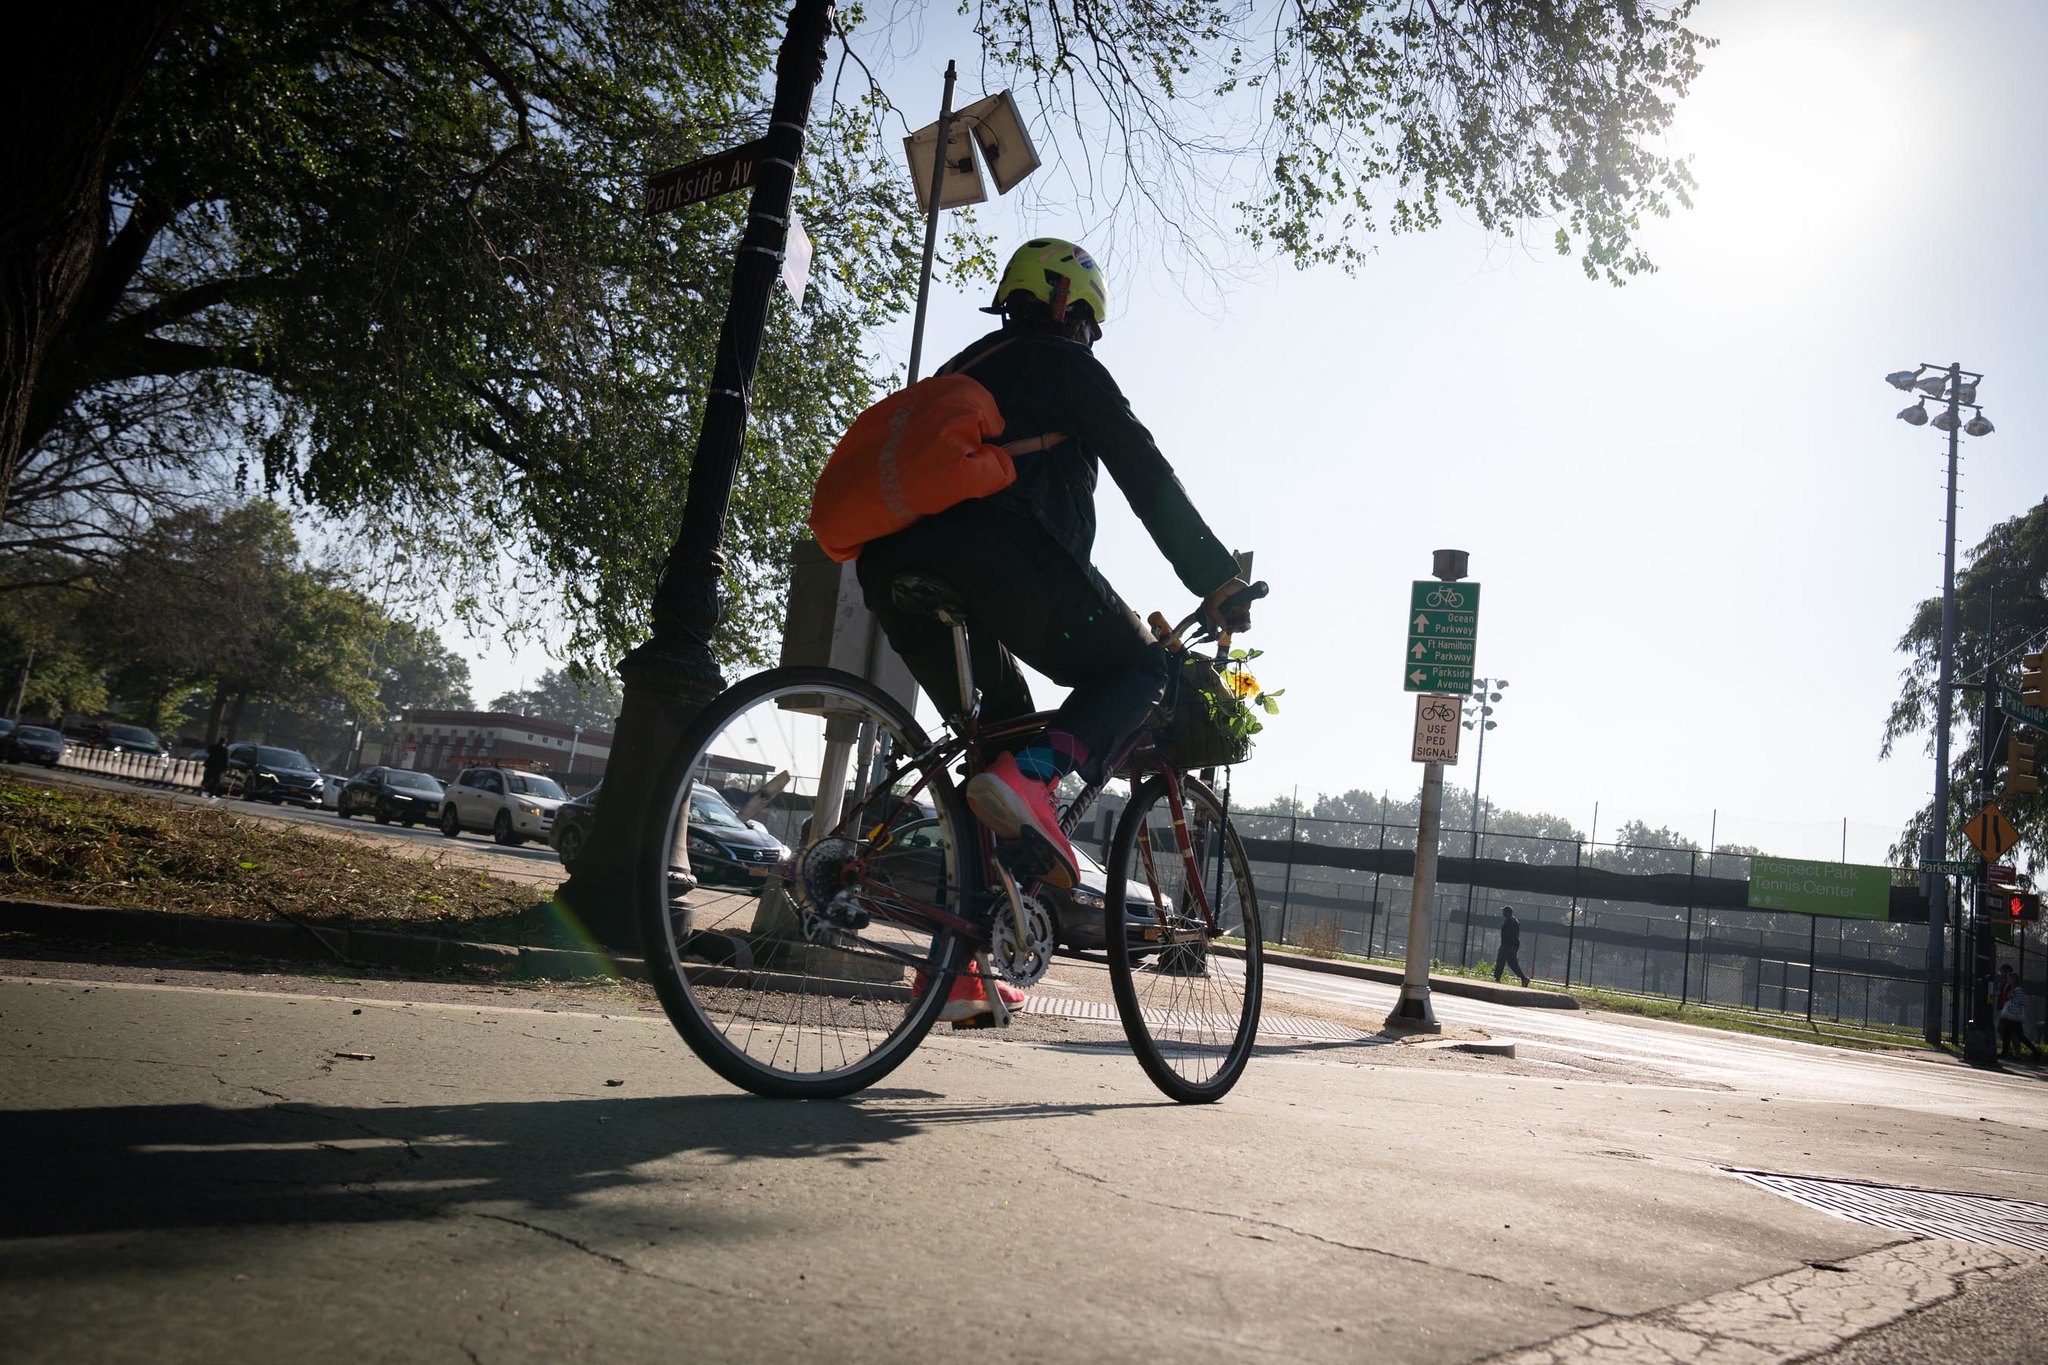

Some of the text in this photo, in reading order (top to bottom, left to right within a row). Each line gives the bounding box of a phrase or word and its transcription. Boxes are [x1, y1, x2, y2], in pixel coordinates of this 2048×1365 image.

[645, 160, 752, 214] Parkside Av
[1448, 613, 1474, 623] Ocean
[1435, 624, 1474, 635] Parkway
[1428, 640, 1472, 650] Ft Hamilton
[1435, 651, 1472, 663] Parkway
[1433, 667, 1470, 678] Parkside
[1437, 680, 1469, 689] Avenue
[1427, 724, 1447, 734] USE
[1426, 736, 1445, 746] PED
[1417, 747, 1453, 758] SIGNAL
[1754, 858, 1858, 879] Prospect Park
[1920, 861, 1965, 874] Parkside
[1753, 875, 1856, 897] Tennis Center
